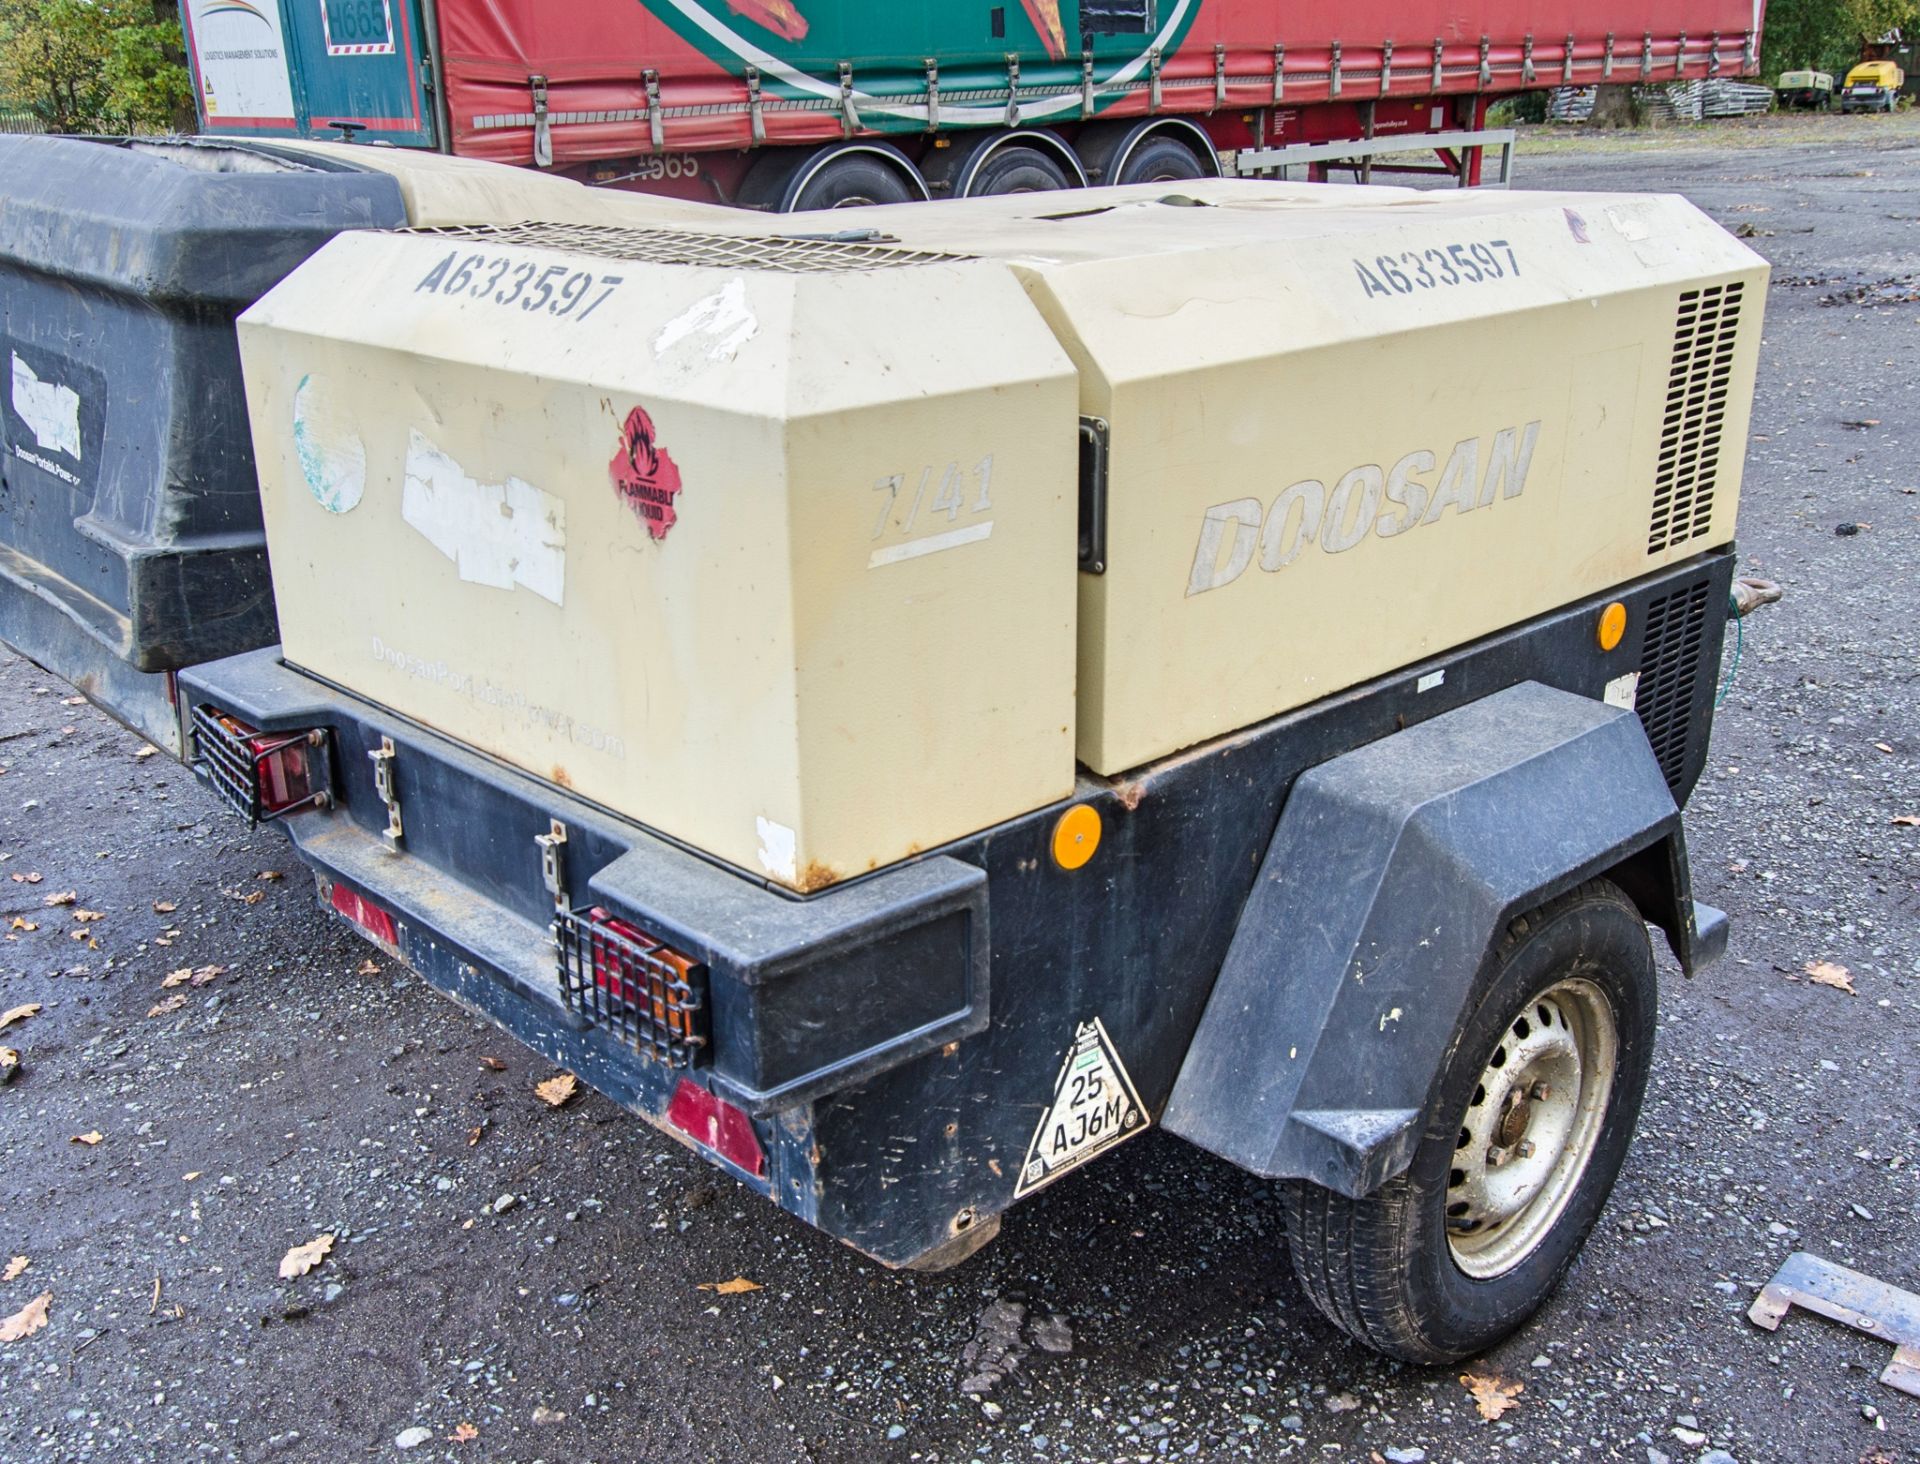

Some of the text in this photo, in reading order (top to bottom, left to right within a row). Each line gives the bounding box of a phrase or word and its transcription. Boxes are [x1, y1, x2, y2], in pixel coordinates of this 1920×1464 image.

[204, 48, 278, 60] LOGISTICS MANAGEMENT SOLUTIONS
[414, 251, 624, 322] A633597
[1353, 240, 1520, 298] A633597
[871, 453, 994, 542] 7/41
[1184, 420, 1541, 599] DOOSAN
[1069, 1066, 1103, 1110] 25
[1052, 1095, 1121, 1156] AJ6M
